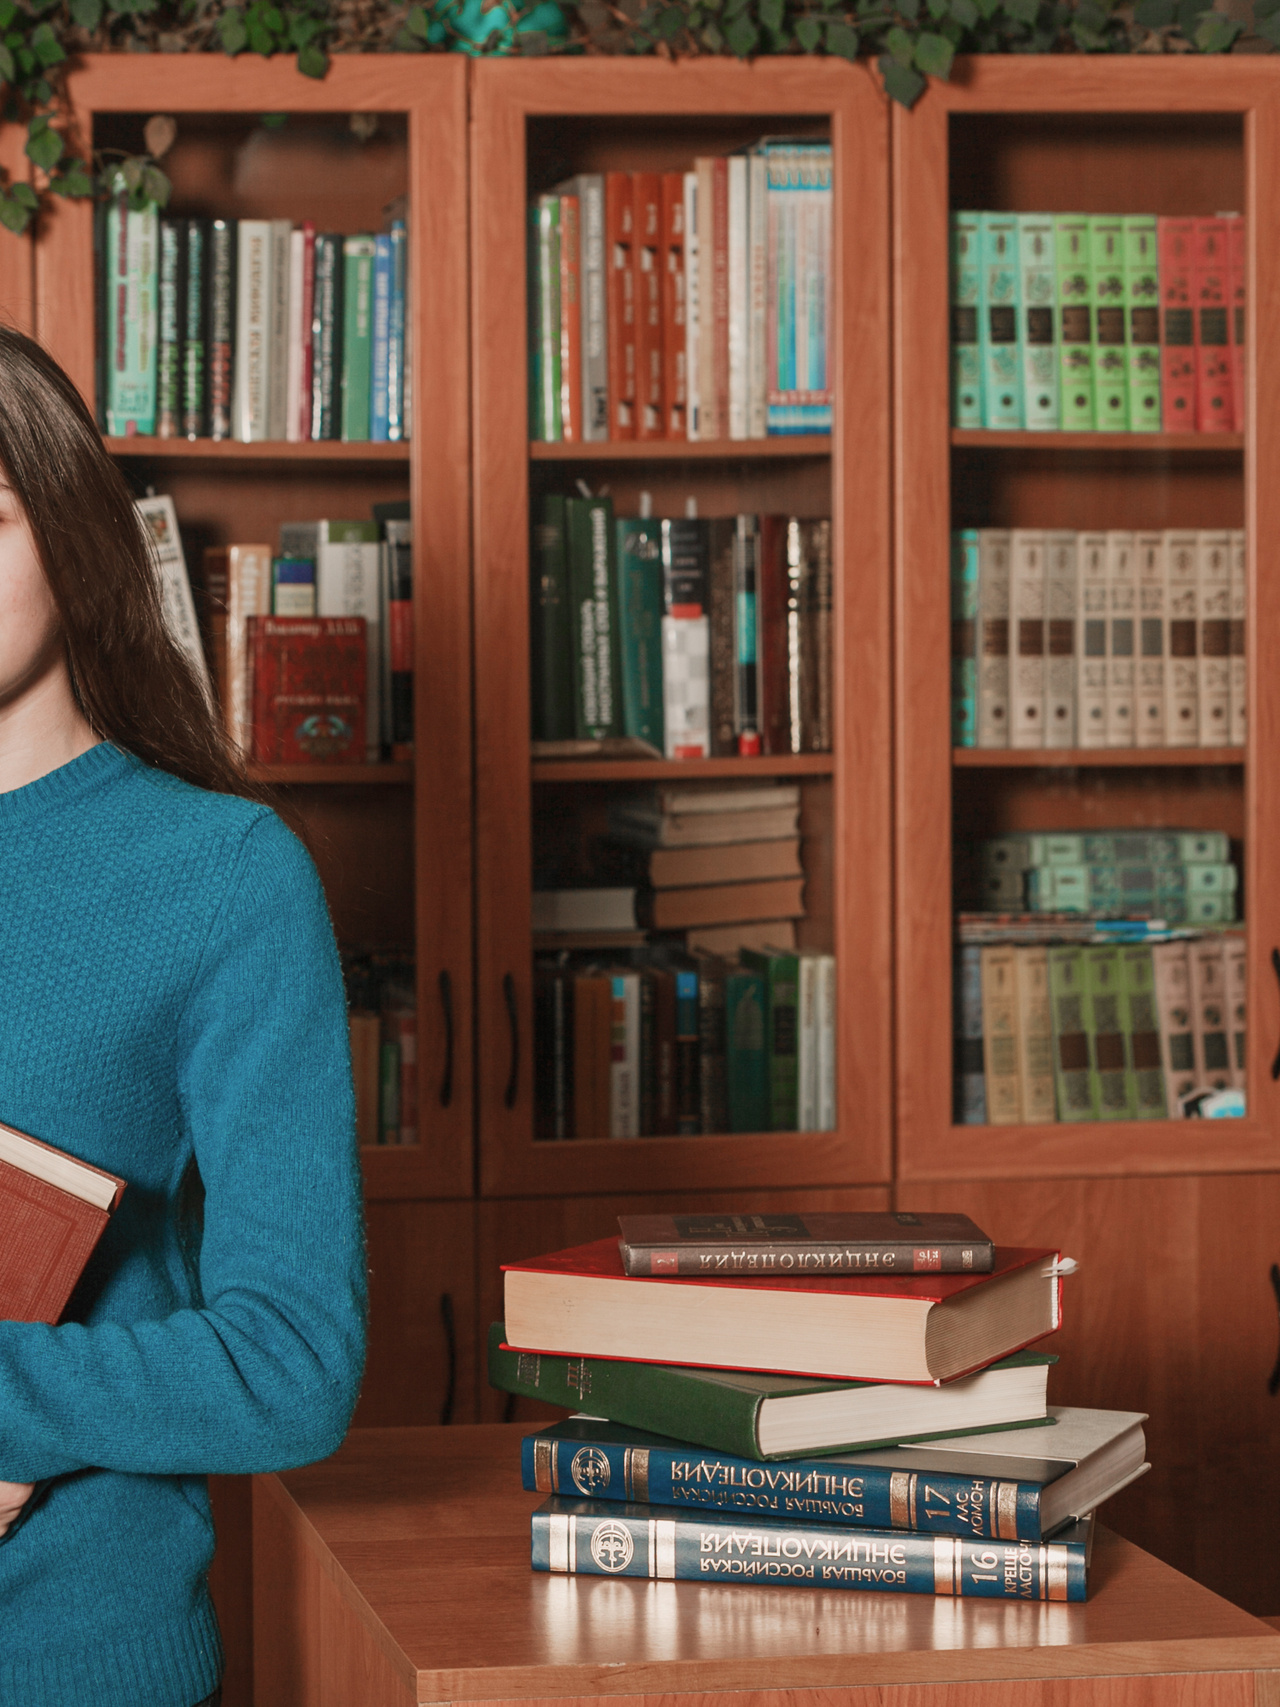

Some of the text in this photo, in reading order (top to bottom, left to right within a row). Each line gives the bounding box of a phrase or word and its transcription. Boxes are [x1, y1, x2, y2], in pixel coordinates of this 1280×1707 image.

[699, 1251, 896, 1270] ЭНЦИКЛОПЕДИЯ
[670, 1460, 865, 1497] ЭНЦИКЛОПЕДИЯ
[672, 1485, 865, 1518] БОЛЬШАЯ РОССИЙСКАЯ
[925, 1484, 951, 1519] 17
[956, 1492, 969, 1522] ЛАС
[970, 1480, 985, 1536] ЛОМОН
[699, 1531, 907, 1565] ЭНЦИКЛОПЕДИЯ
[700, 1557, 907, 1585] БОЛЬШАЯ РОССИЙСКАЯ
[970, 1551, 999, 1584] 16
[1004, 1547, 1019, 1593] КРЕЩЕ
